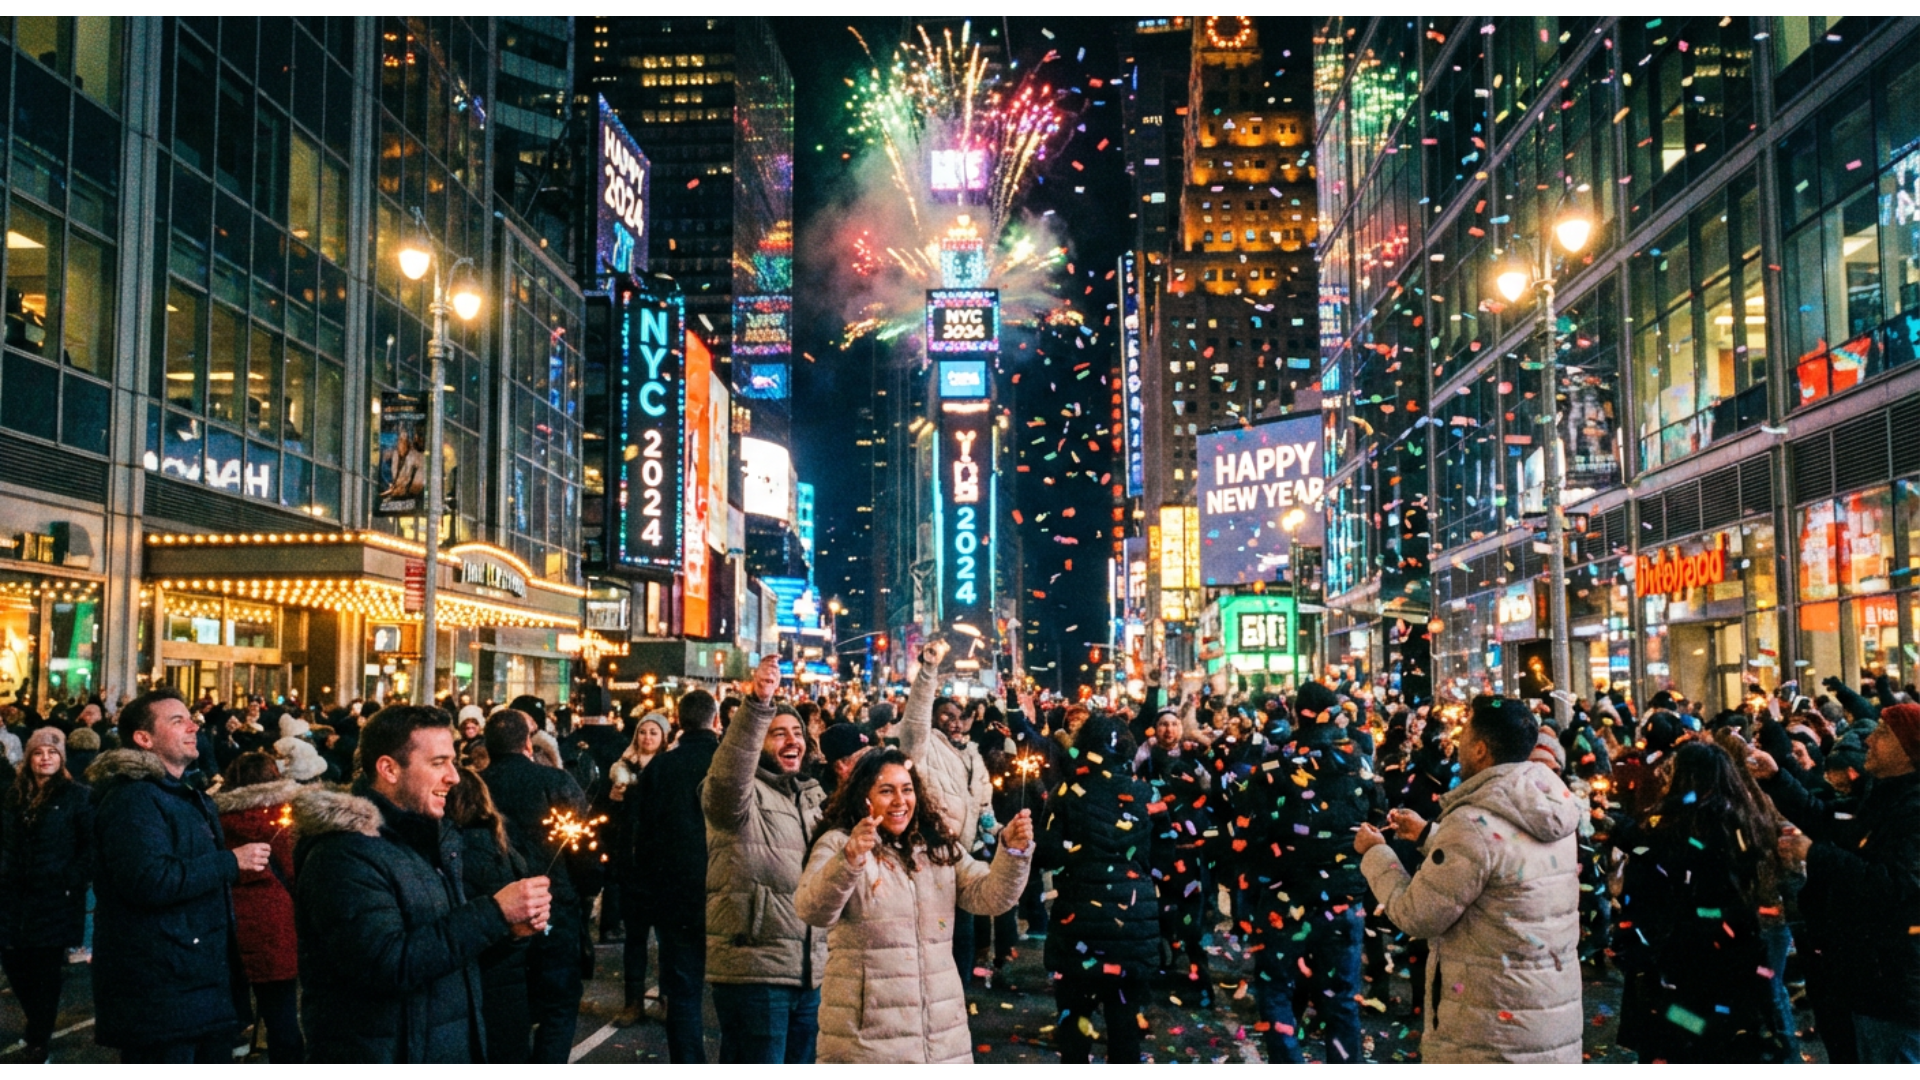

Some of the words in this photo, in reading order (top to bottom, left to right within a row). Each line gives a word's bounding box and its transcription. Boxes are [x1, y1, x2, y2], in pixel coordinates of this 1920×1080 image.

[605, 126, 645, 194] HAPPY
[605, 165, 644, 237] 2024
[945, 309, 983, 324] NYC
[639, 308, 668, 417] NYC
[641, 429, 663, 546] 2024
[1215, 442, 1316, 485] HAPPY
[1206, 485, 1258, 514] NEW
[955, 506, 977, 605] 2024
